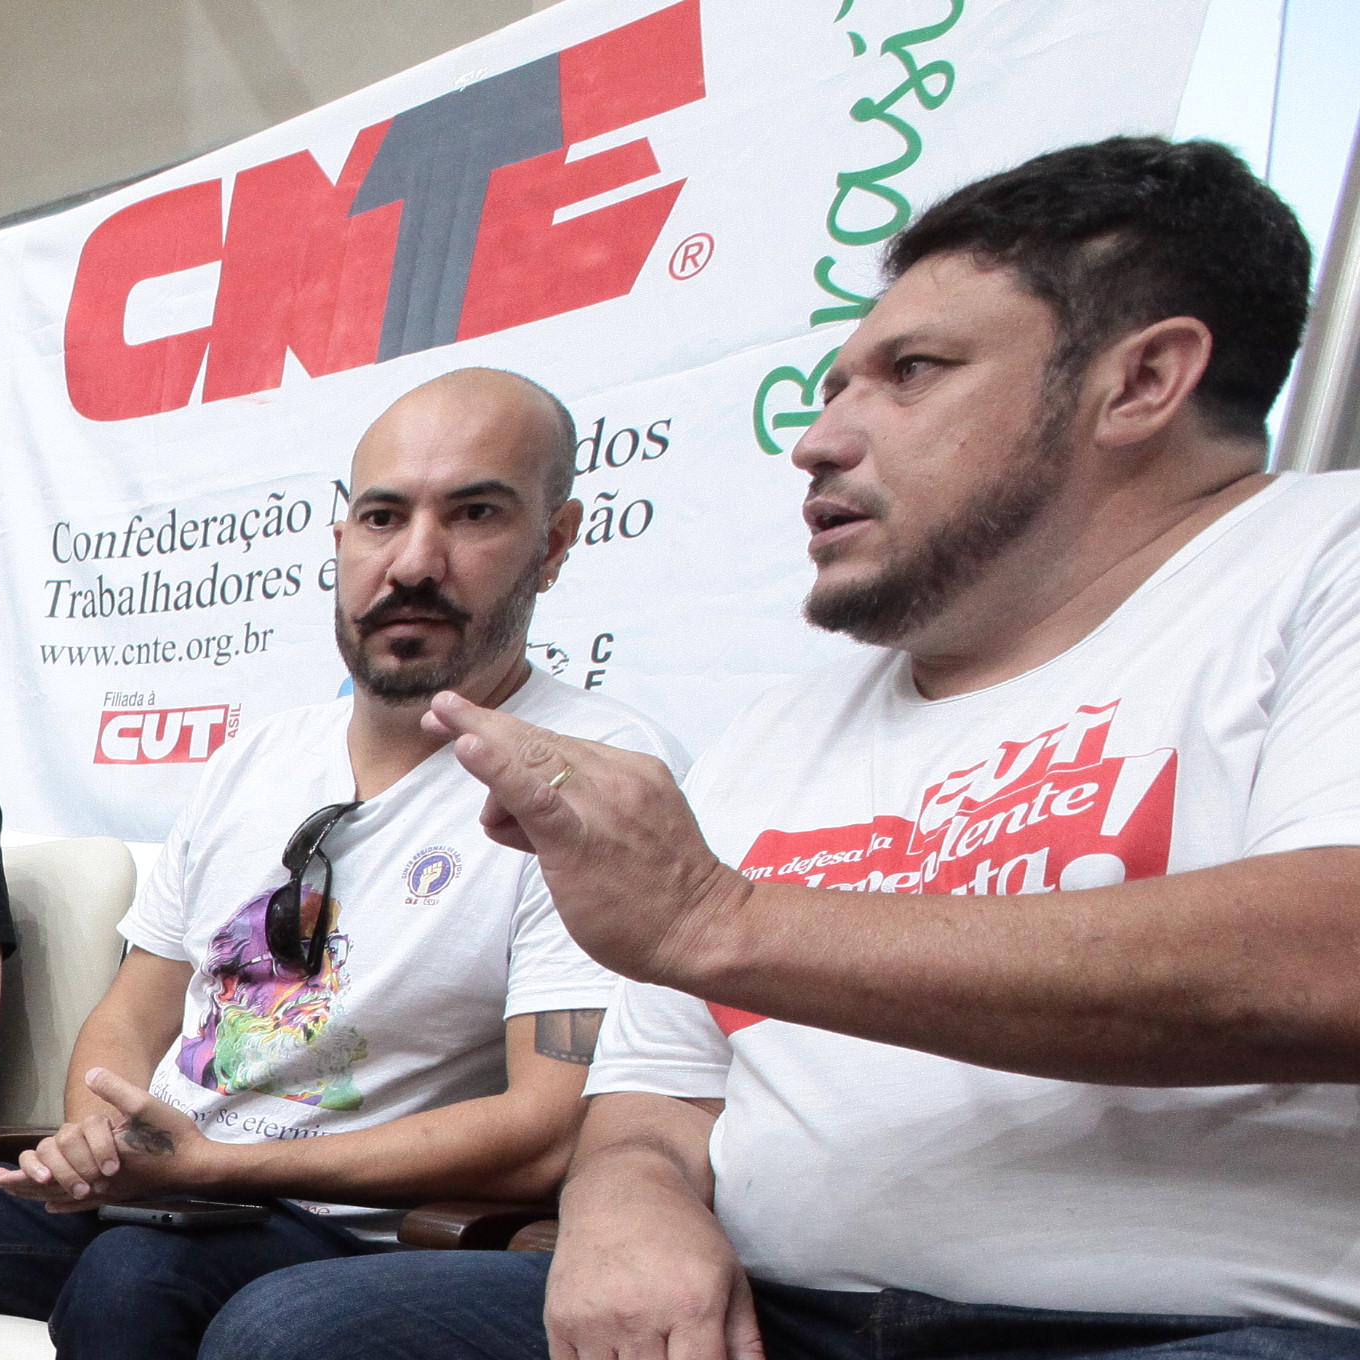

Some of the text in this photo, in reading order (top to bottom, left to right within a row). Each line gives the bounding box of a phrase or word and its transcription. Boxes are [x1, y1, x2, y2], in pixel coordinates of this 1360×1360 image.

[64, 2, 707, 422] CNTE
[574, 416, 673, 478] dos
[51, 490, 313, 565] Confederação
[43, 561, 303, 619] Trabalhadores
[38, 621, 274, 666] www.cnte.org.br
[102, 691, 139, 708] Filiada
[99, 706, 227, 761] CUT
[919, 706, 1118, 836] CUT
[778, 847, 864, 877] defesa
[216, 1108, 239, 1127] se
